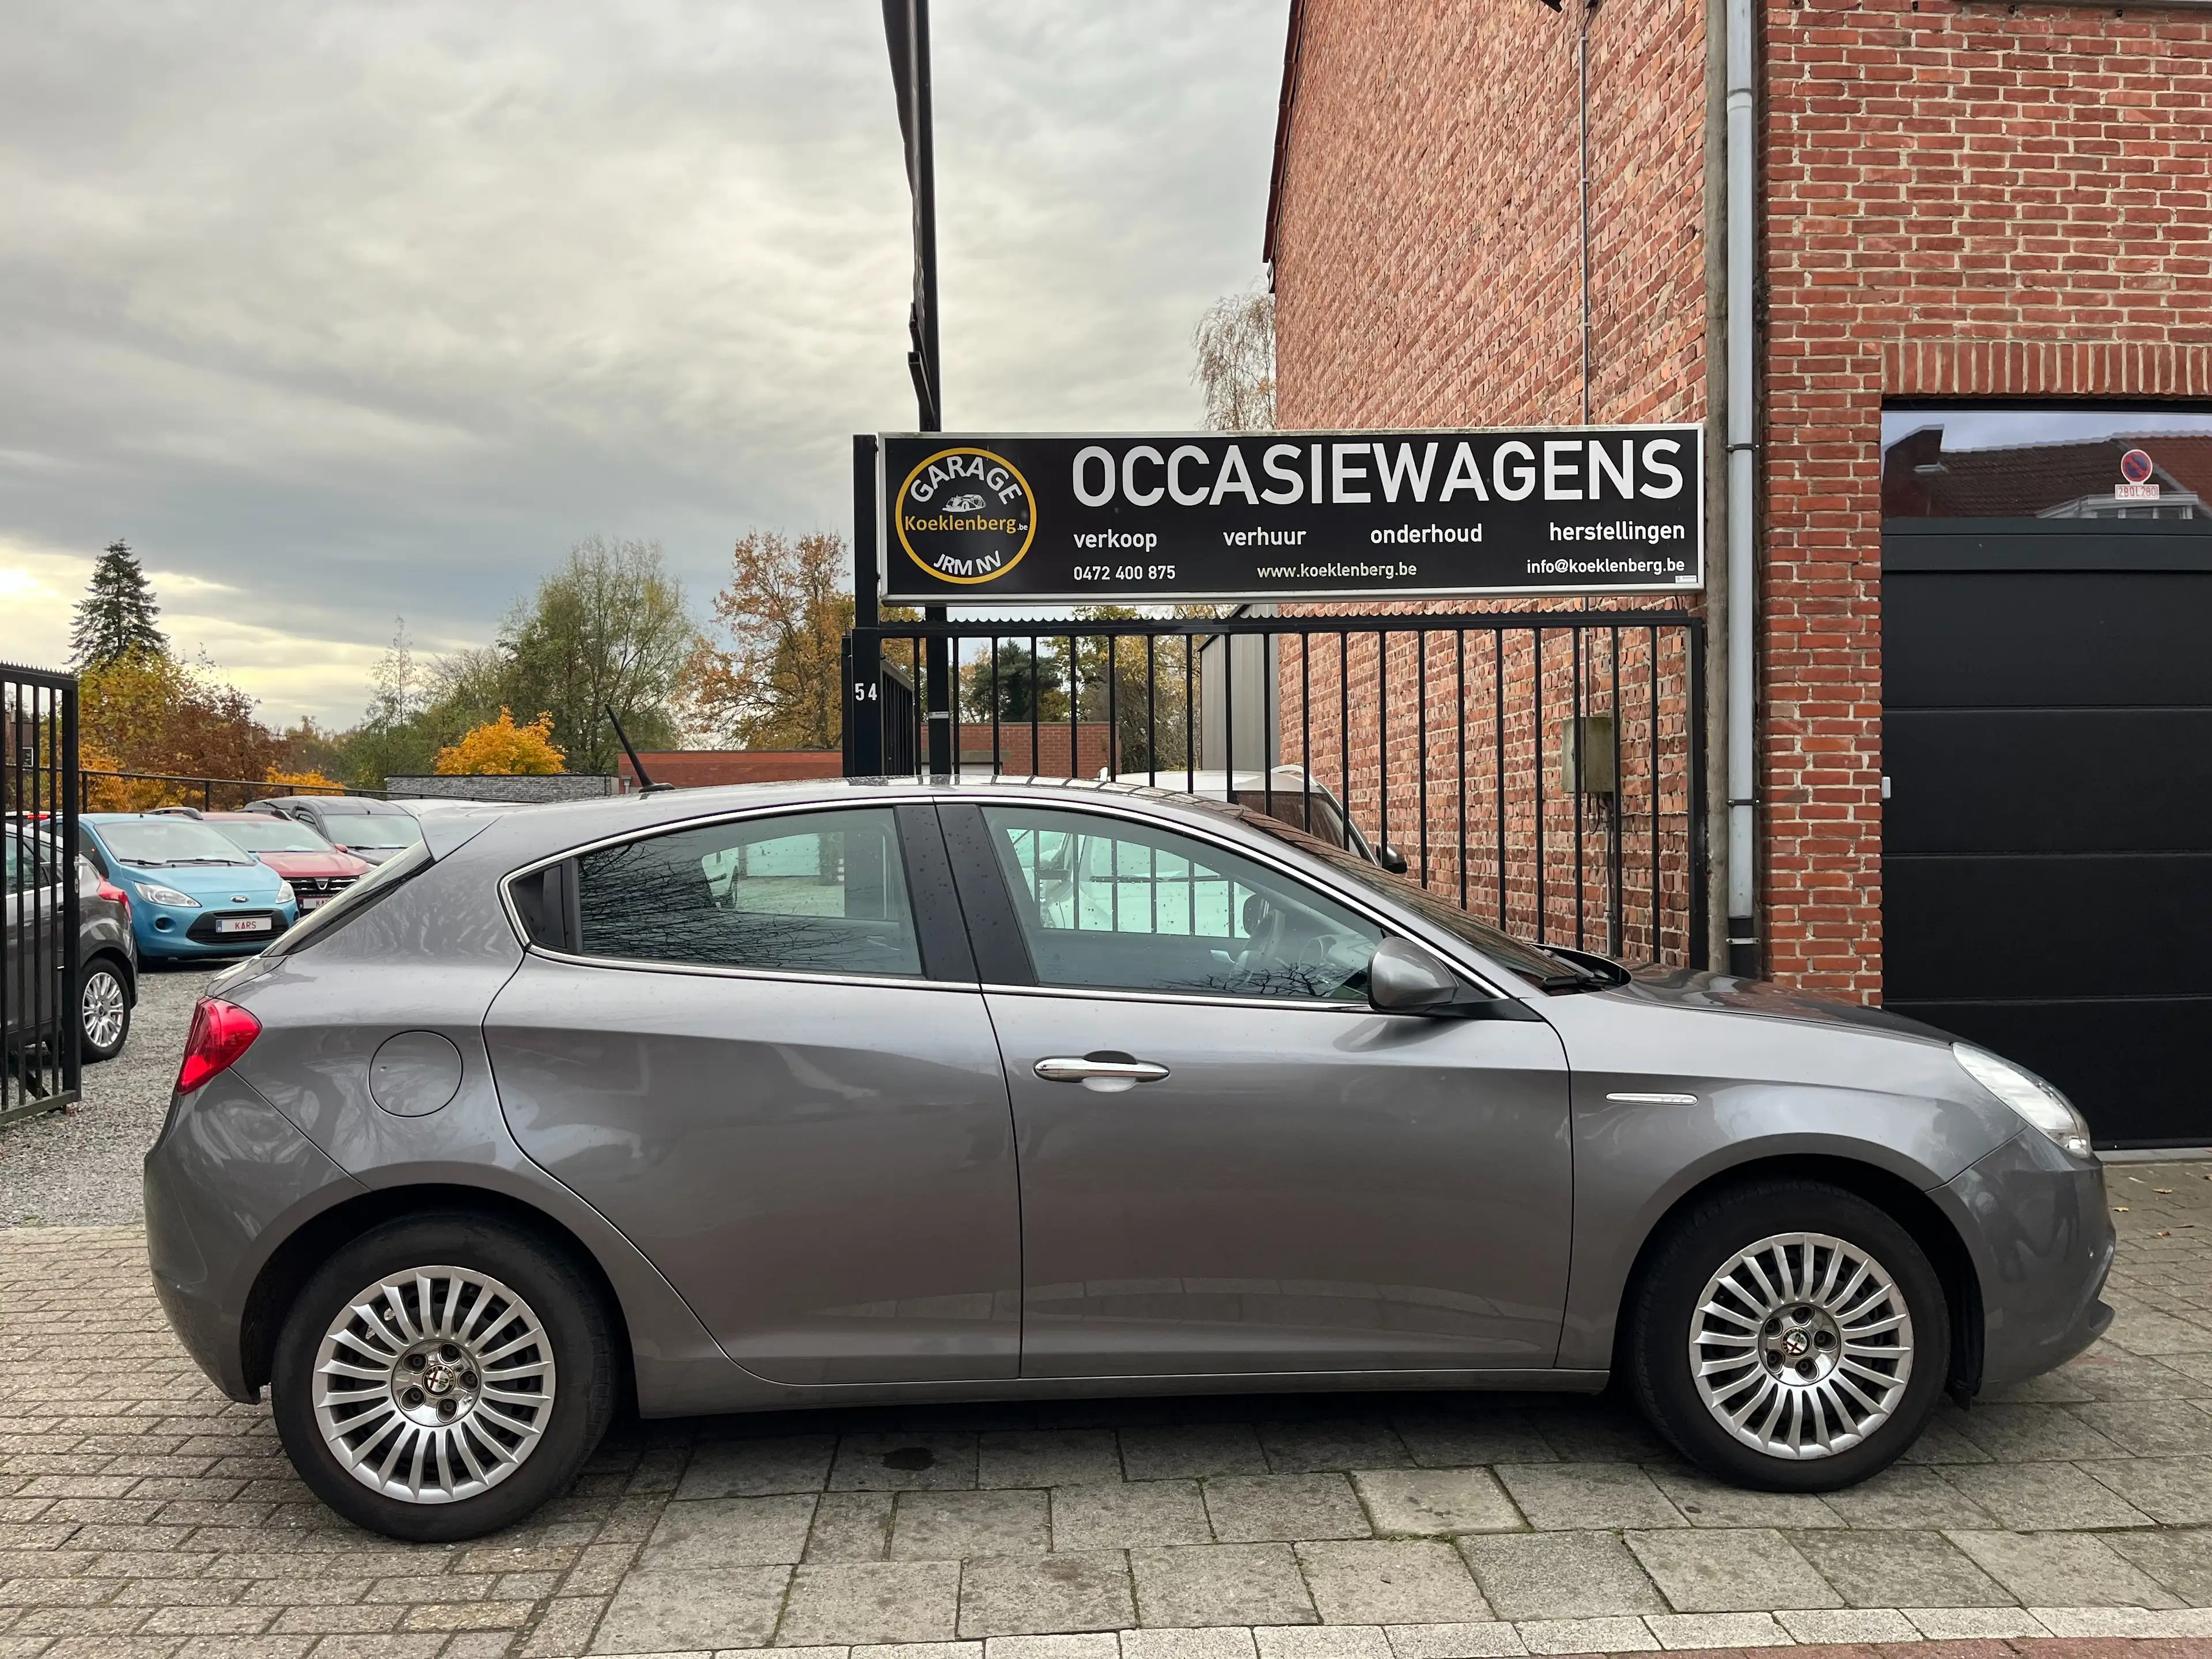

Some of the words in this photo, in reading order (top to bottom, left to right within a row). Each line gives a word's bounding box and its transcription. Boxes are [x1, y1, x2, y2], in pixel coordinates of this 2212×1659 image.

[911, 456, 1022, 505] GARAGE
[1073, 439, 1683, 507] OCCASIEWAGENS
[1074, 529, 1157, 552] verkoop
[1223, 527, 1307, 546] verhuur
[1371, 523, 1482, 544] onderhoud
[1550, 521, 1685, 544] herstellingen
[933, 554, 972, 575] JRM
[975, 550, 1001, 574] NV
[1257, 562, 1417, 579] www.koeklenberg.be
[1527, 557, 1685, 574] info@koeklenberg.be
[1074, 566, 1111, 581] 0472
[1115, 565, 1143, 580] 400
[1148, 565, 1176, 579] 875
[855, 683, 877, 701] 54
[316, 899, 329, 907] KA
[235, 921, 256, 930] KARS
